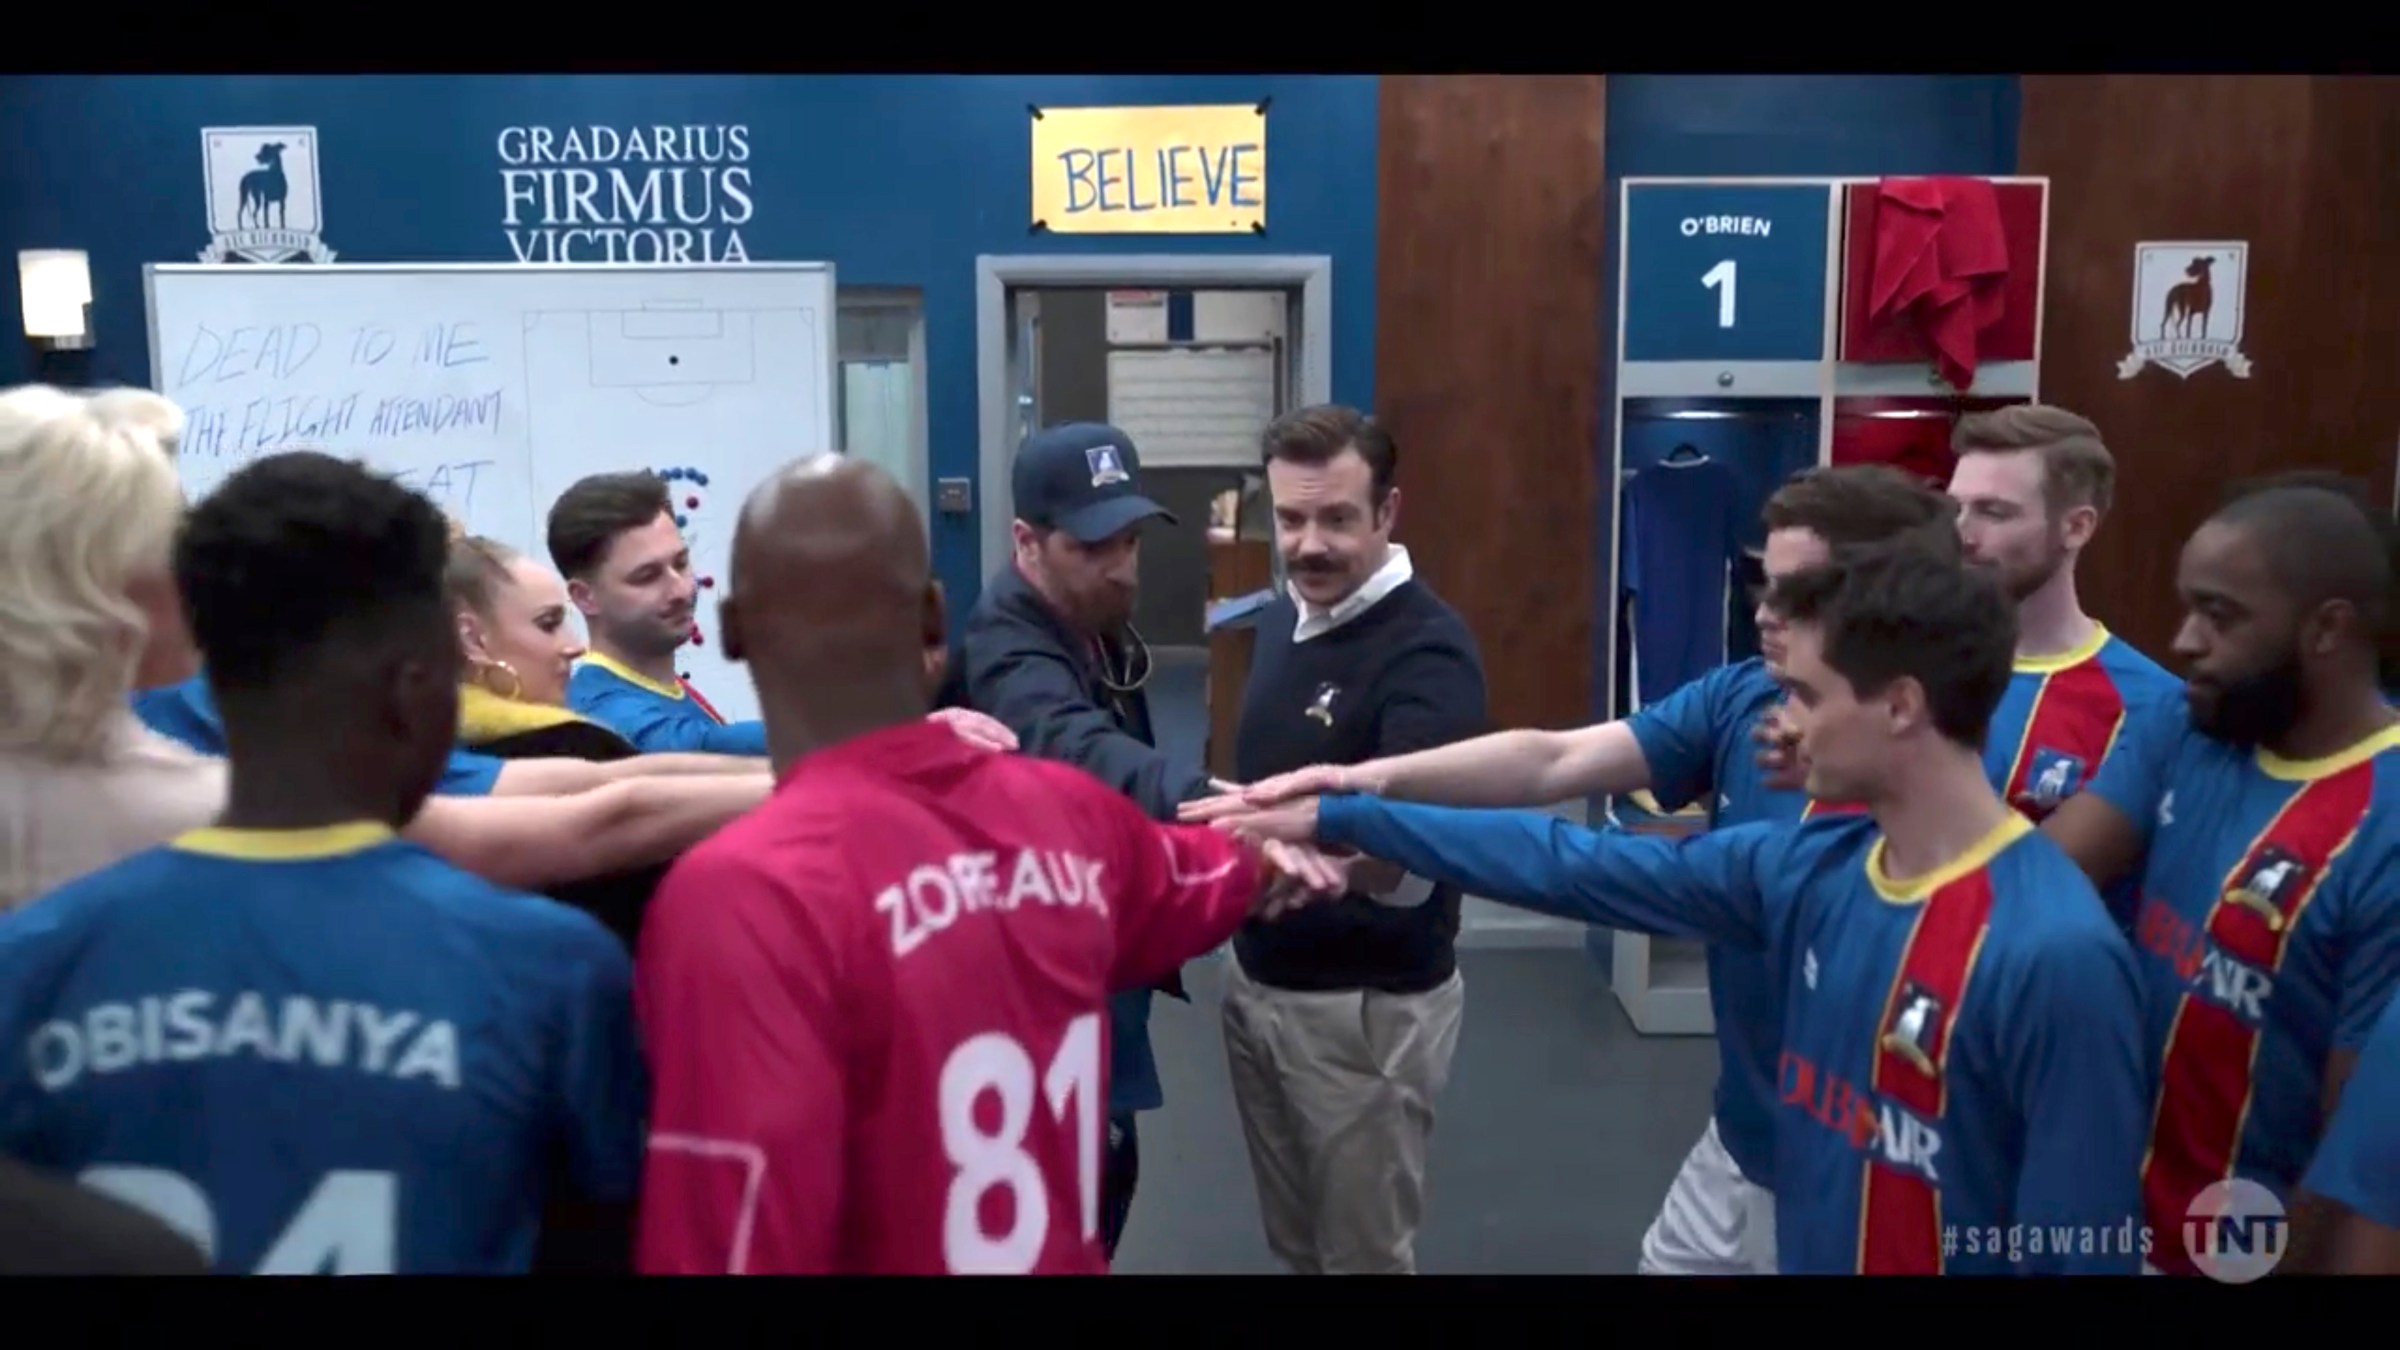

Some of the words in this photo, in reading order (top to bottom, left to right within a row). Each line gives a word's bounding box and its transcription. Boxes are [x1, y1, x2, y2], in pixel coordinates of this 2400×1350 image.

[498, 124, 751, 163] GRADARIUS
[499, 166, 754, 224] FIRMUS
[1057, 143, 1262, 213] BELIEVE
[504, 228, 750, 262] VICTORIA
[1680, 215, 1772, 237] O'BRIEN
[1701, 259, 1737, 328] 1
[178, 321, 322, 388] DEAD
[350, 325, 395, 367] TO
[412, 320, 490, 368] ME
[238, 390, 363, 451] FLIGHT
[368, 388, 504, 437] ATTENDANT
[30, 987, 462, 1091] OBISANYA
[938, 1012, 1102, 1274] 81
